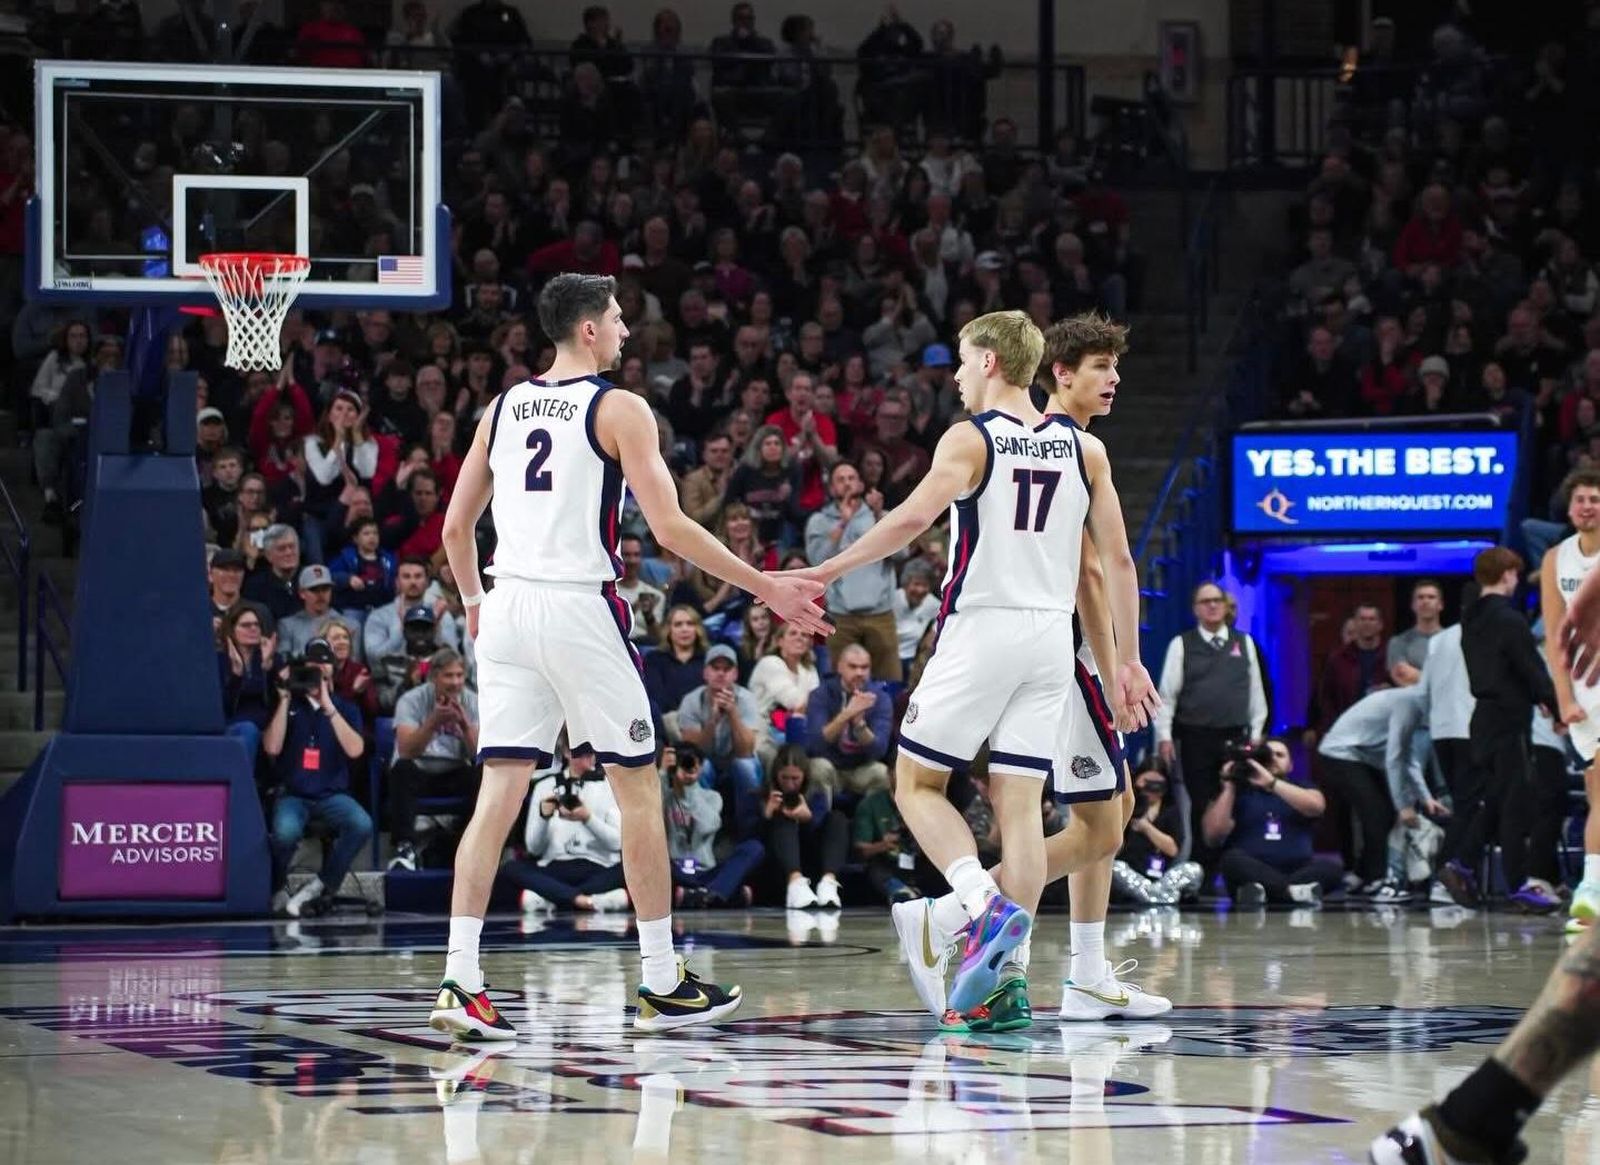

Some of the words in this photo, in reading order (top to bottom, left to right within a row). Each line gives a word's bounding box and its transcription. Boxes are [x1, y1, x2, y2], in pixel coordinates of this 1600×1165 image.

[512, 398, 578, 422] VENTERS
[525, 428, 553, 491] 2
[1404, 447, 1505, 475] BEST.
[1012, 468, 1062, 532] 17
[1307, 494, 1493, 512] NORTHERNQUEST.COM
[111, 846, 215, 864] ADVISORS
